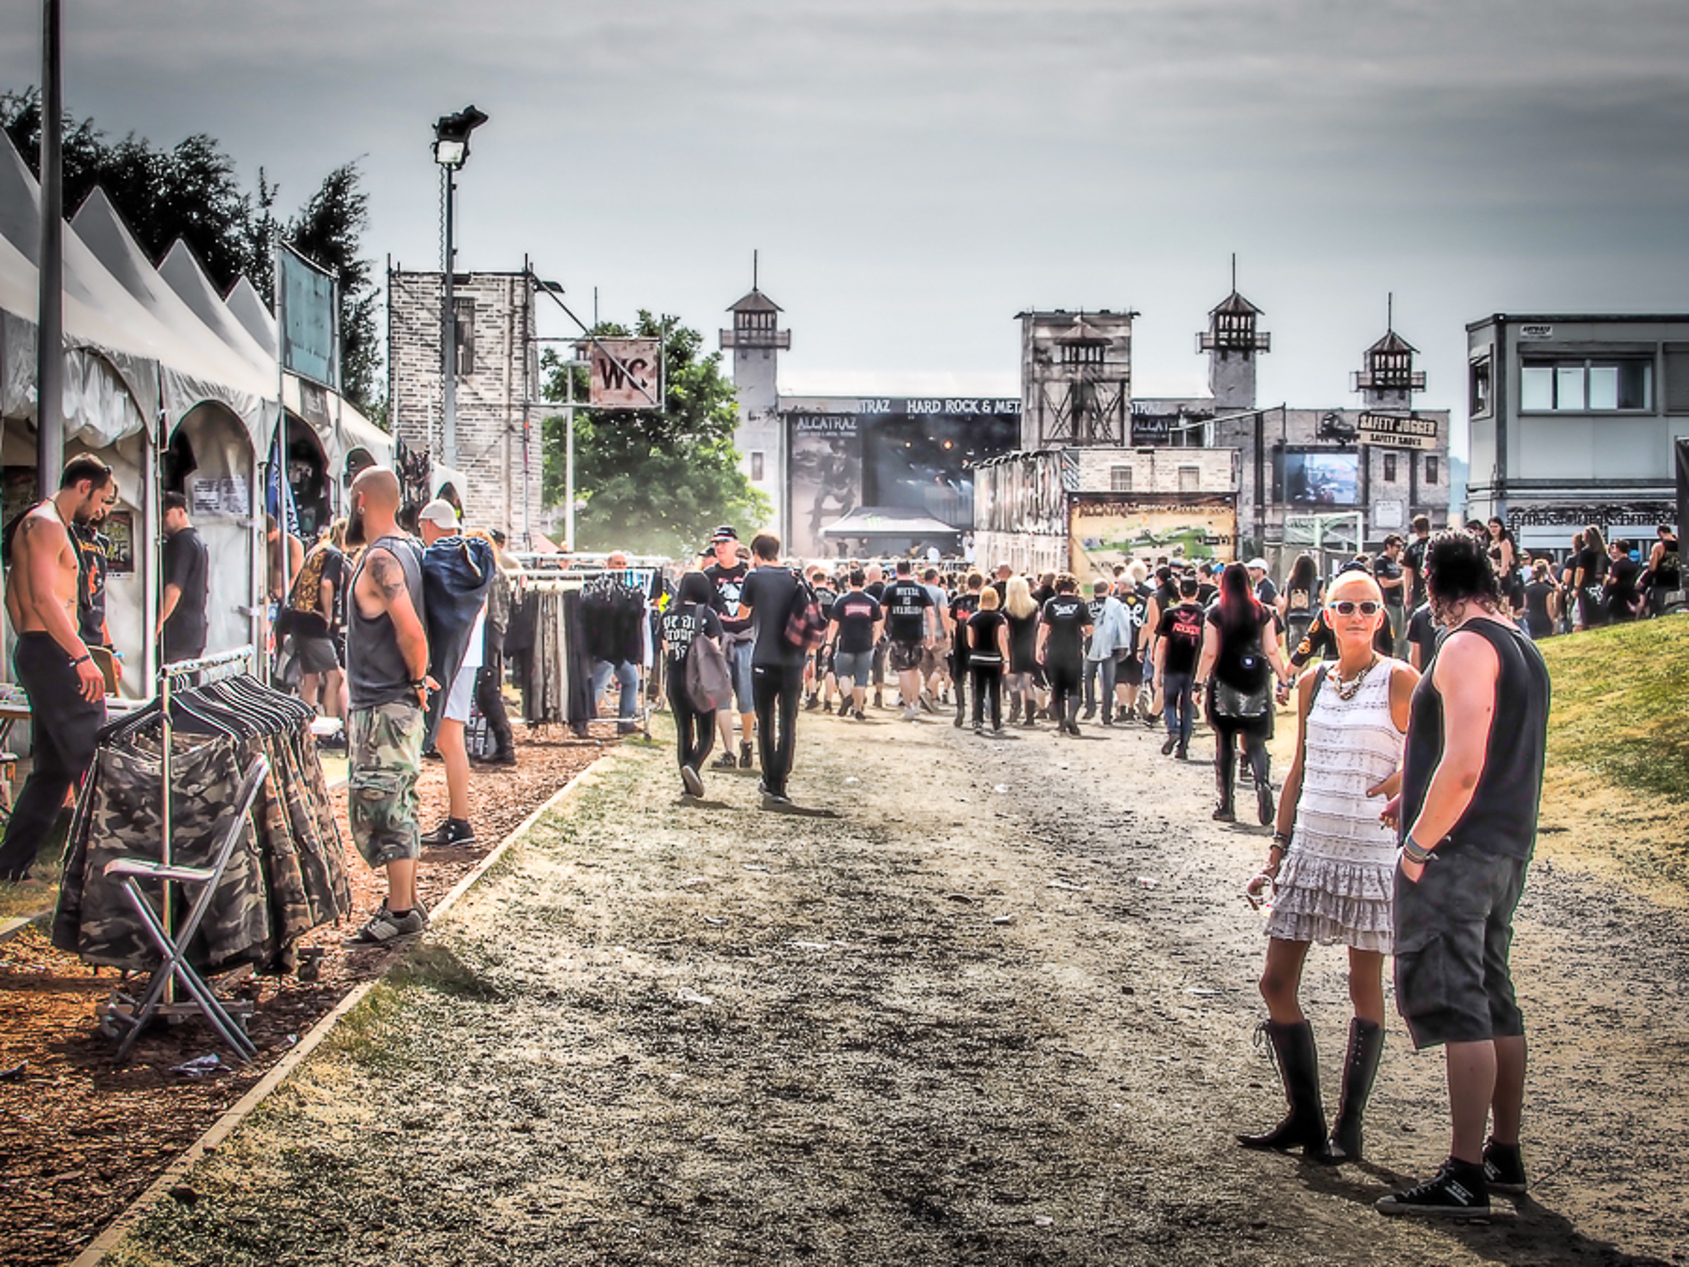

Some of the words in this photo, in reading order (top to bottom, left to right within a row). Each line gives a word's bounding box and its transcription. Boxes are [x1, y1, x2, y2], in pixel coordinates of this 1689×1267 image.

[599, 358, 648, 391] WC
[907, 400, 941, 413] HARD
[945, 400, 978, 413] ROCK
[981, 401, 991, 412] &
[797, 416, 857, 430] ALCATRAZ
[1360, 415, 1395, 431] SAFETY
[1397, 419, 1435, 434] JOGGER
